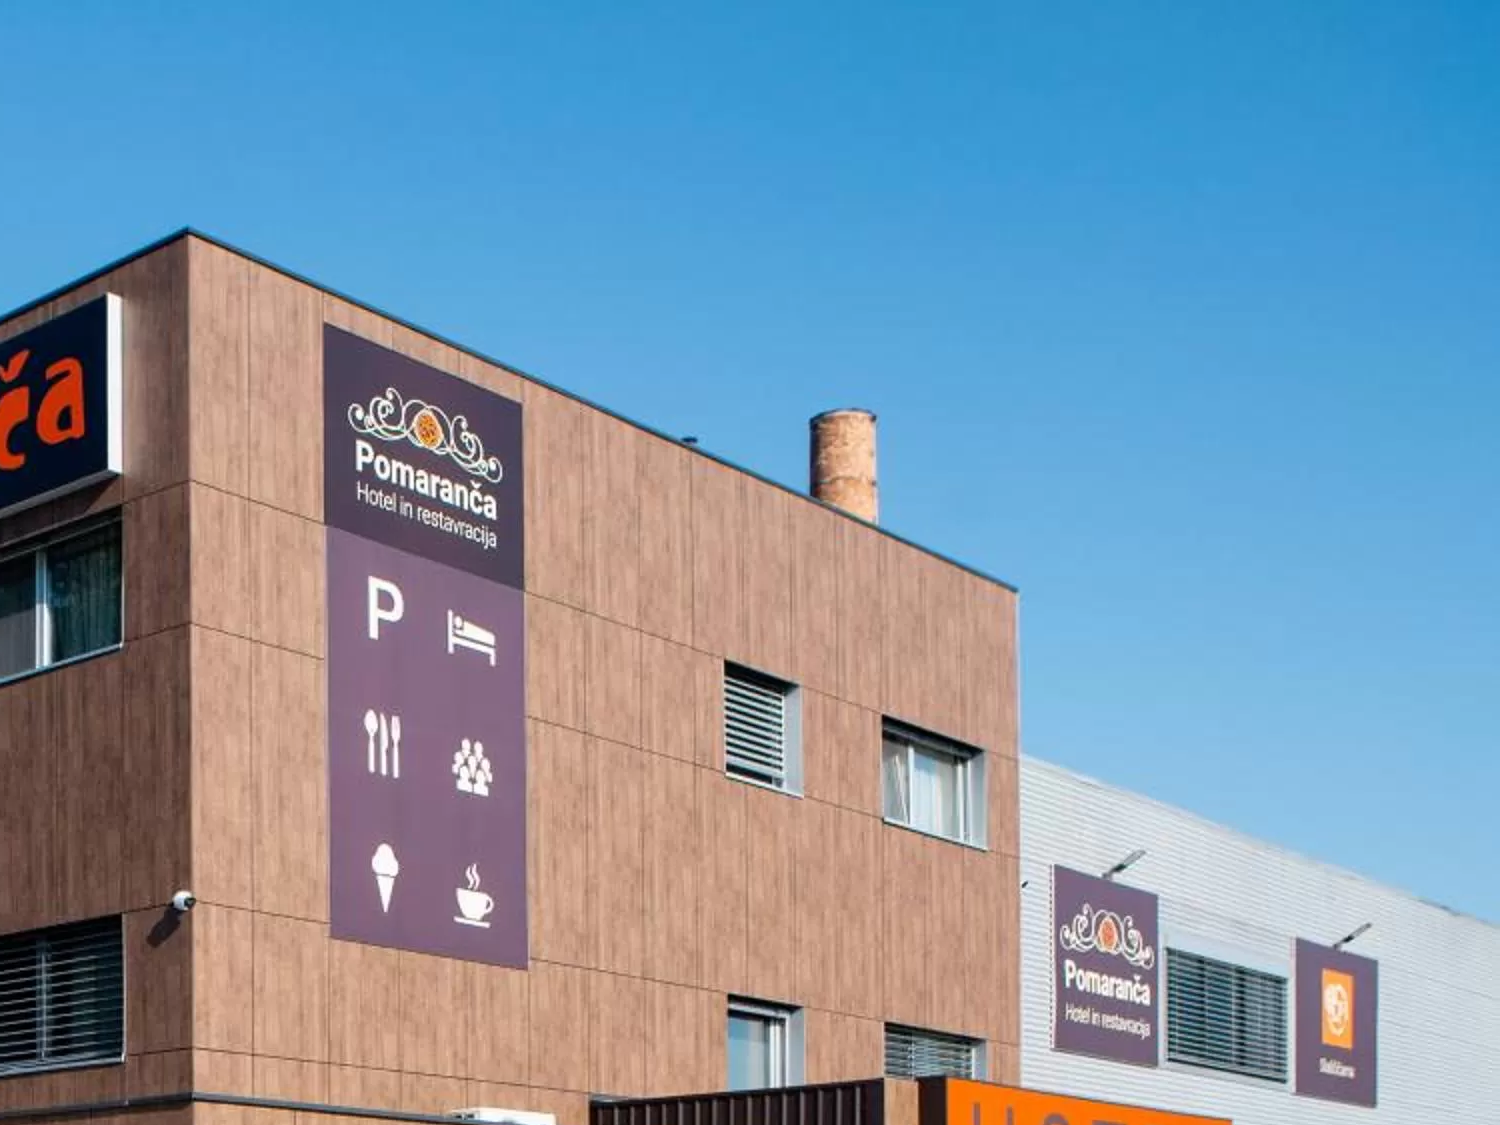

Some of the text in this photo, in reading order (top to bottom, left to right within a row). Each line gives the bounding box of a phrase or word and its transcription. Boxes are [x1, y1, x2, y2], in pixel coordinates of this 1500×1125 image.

[355, 439, 498, 521] Pomaranča
[356, 480, 498, 549] Hotel in restavracija
[367, 575, 405, 640] P
[1064, 958, 1152, 1007] Pomaranča
[1065, 1001, 1091, 1024] Hotel
